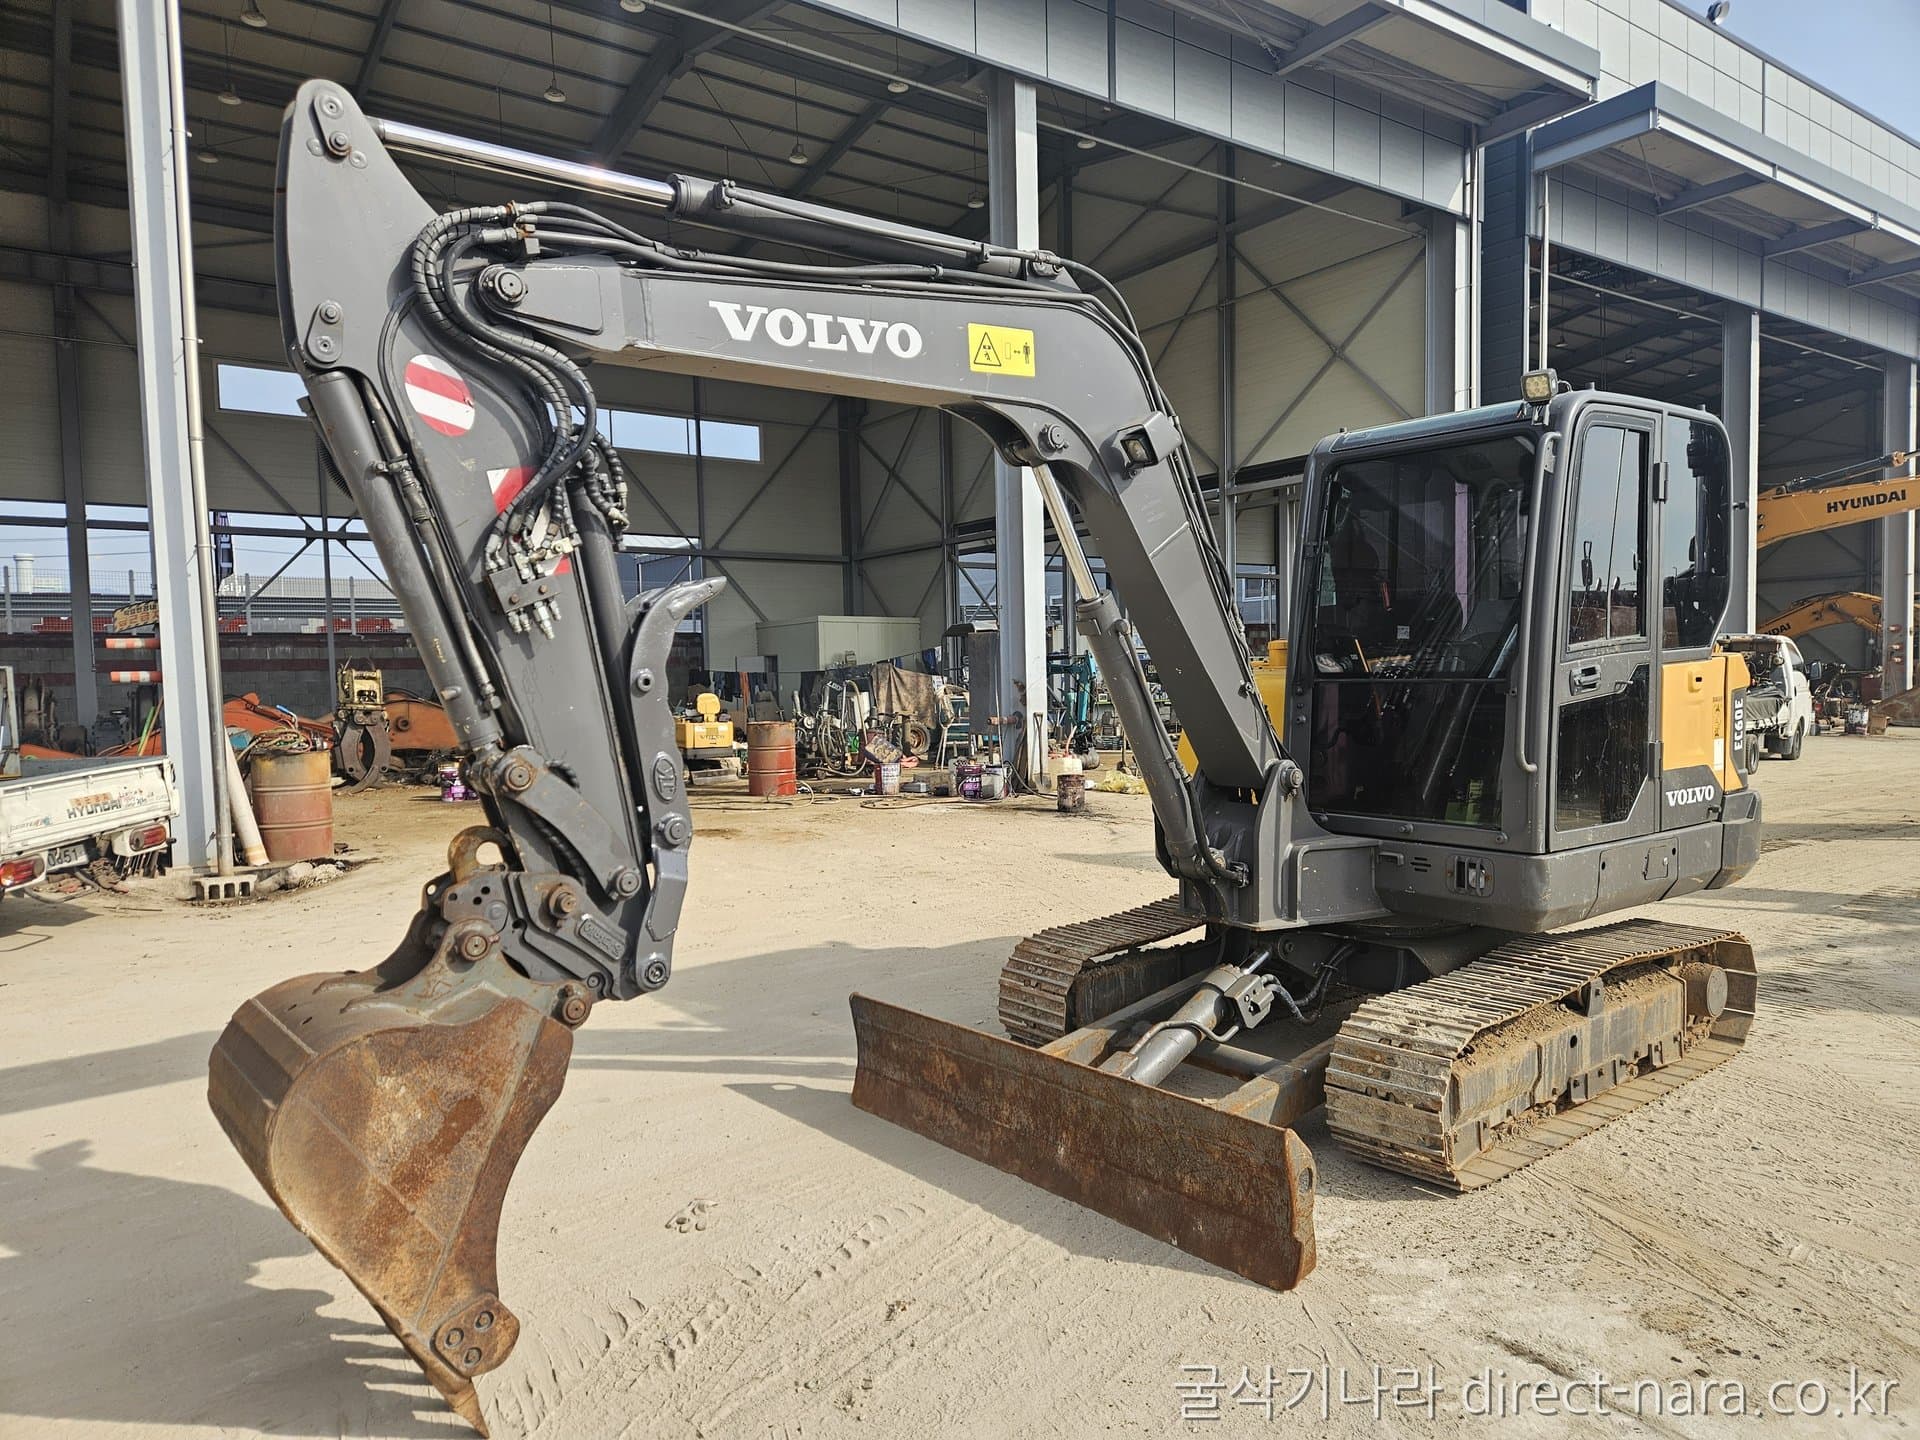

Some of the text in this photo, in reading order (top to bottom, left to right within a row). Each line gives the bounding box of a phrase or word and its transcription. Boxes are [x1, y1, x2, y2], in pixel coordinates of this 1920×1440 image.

[709, 300, 923, 359] VOLVO
[1826, 489, 1907, 513] HYUNDAI
[1734, 699, 1744, 751] EC60E
[1666, 785, 1715, 807] VOLVO
[67, 799, 122, 819] HYUNDAI
